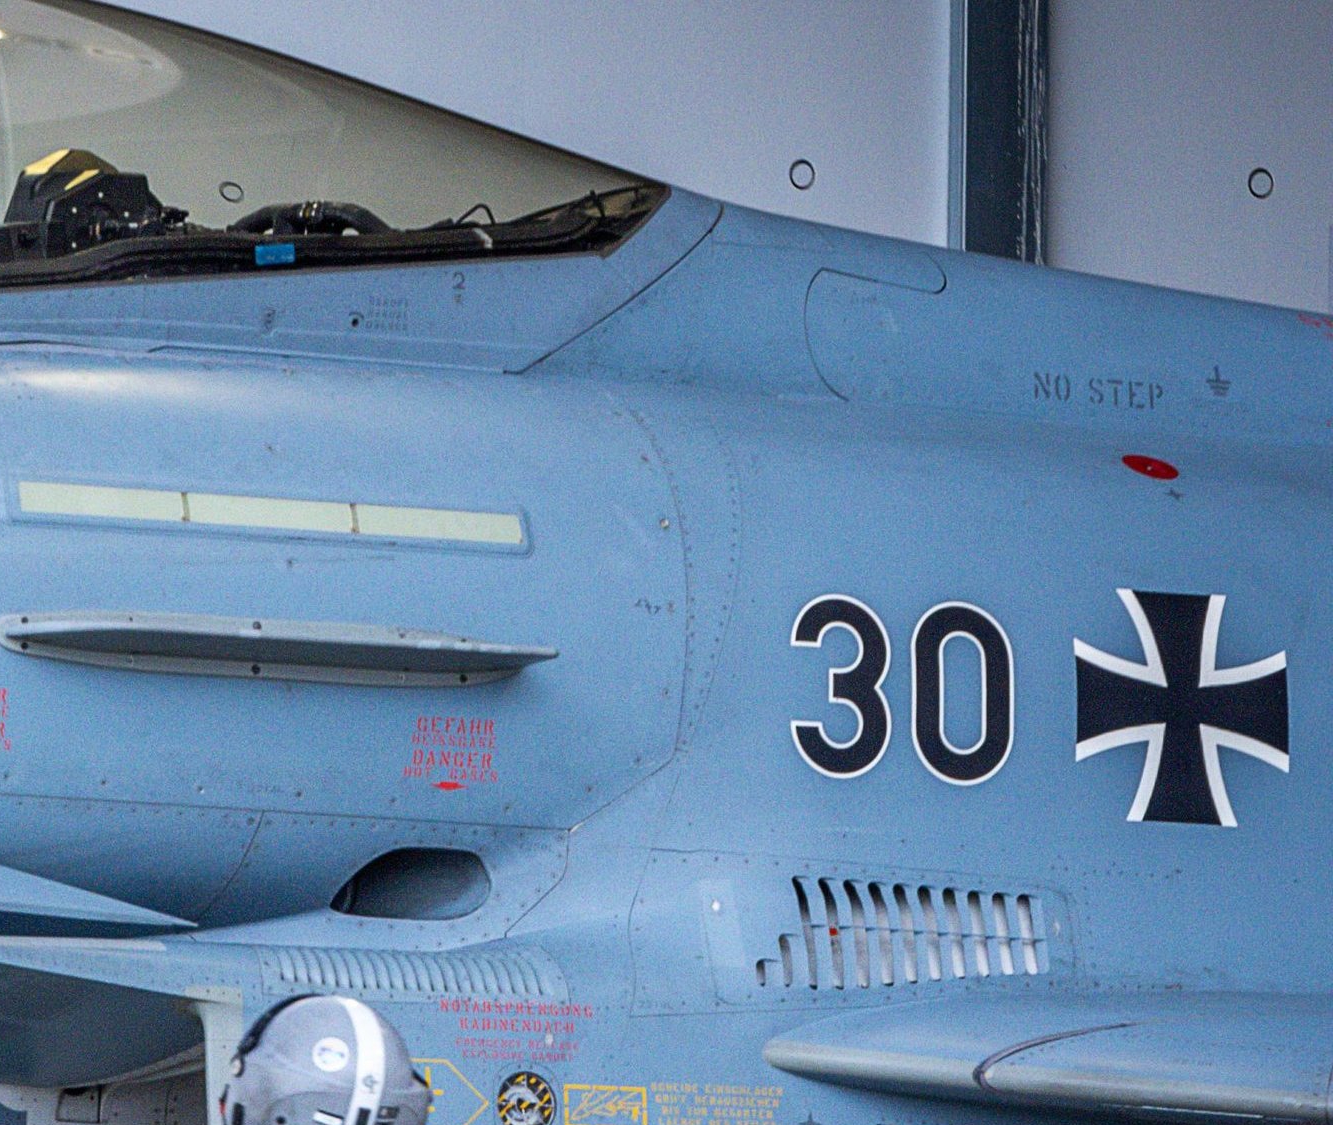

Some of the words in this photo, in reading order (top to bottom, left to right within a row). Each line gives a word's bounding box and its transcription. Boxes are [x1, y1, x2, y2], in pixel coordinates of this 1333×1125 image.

[1033, 372, 1071, 401] NO
[1088, 376, 1164, 409] STEP
[790, 593, 1015, 787] 30
[416, 715, 495, 734] GEFAHR
[412, 749, 493, 769] DANGER
